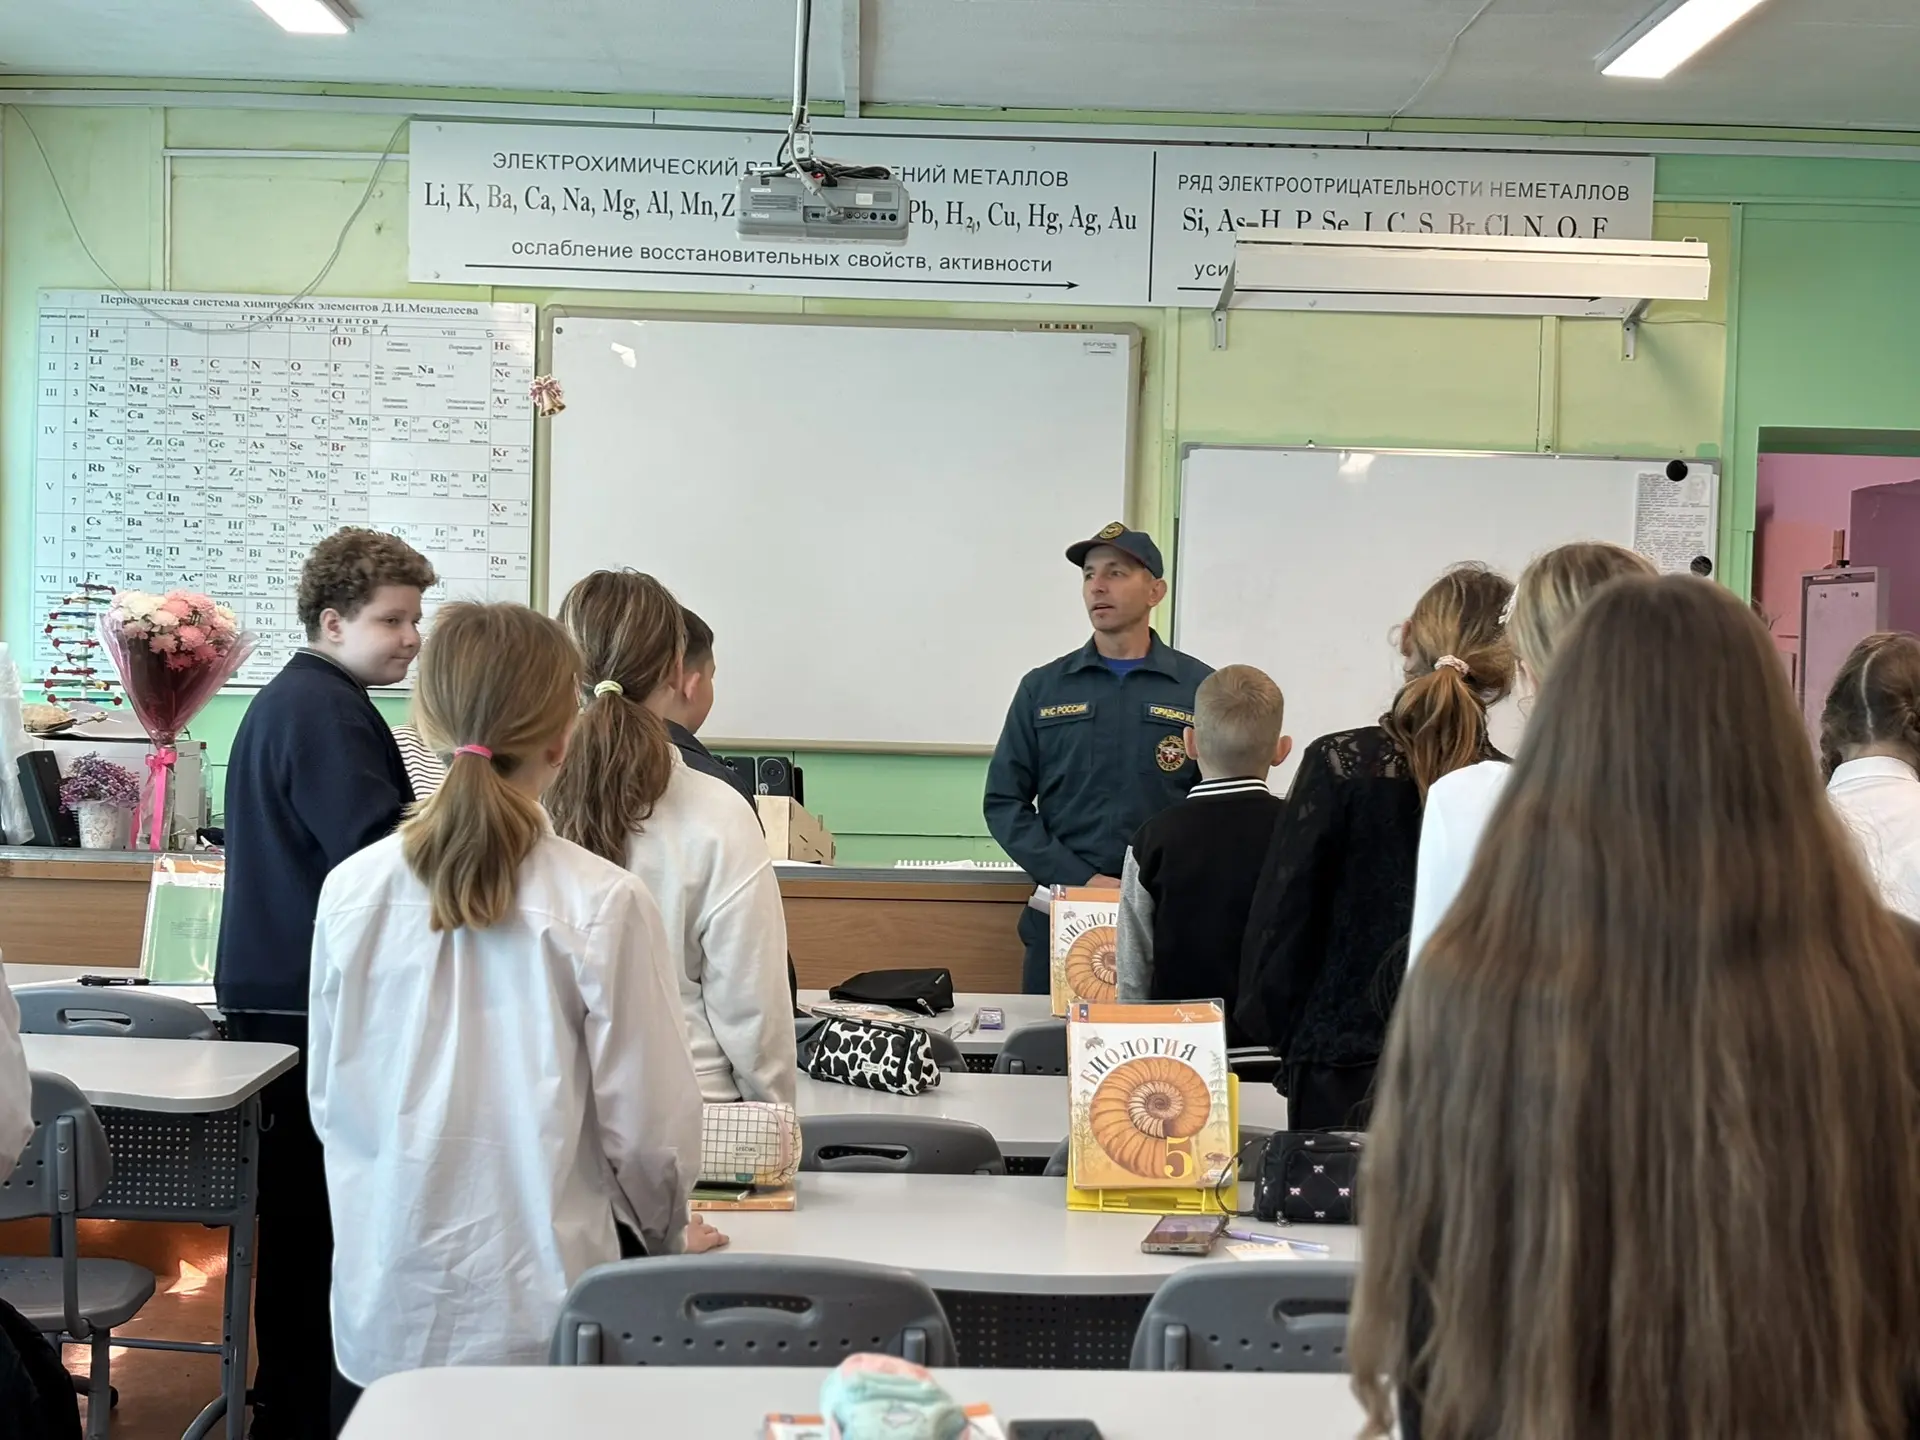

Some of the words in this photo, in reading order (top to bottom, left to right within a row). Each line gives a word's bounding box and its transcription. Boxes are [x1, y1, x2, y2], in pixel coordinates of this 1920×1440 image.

[493, 152, 738, 178] ЭЛЕКТРОХИМИЧЕСКИЙ
[953, 168, 1069, 187] МЕТАЛЛОВ
[1178, 174, 1213, 193] РЯД
[1218, 176, 1483, 198] ЭЛЕКТРООТРИЦАТЕЛЬНОСТИ
[1490, 182, 1630, 201] НЕМЕТАЛЛОВ
[425, 182, 451, 213] Li,
[457, 184, 480, 214] K,
[487, 184, 517, 215] Ba,
[525, 186, 556, 216] Ca,
[563, 187, 596, 217] Na,
[603, 189, 640, 220] Mg,
[647, 190, 673, 220] Al,
[909, 200, 938, 230] Pb,
[988, 202, 1020, 233] Cu,
[1028, 203, 1063, 235] Hg,
[1068, 205, 1101, 236] Ag,
[1108, 206, 1137, 230] Au
[1183, 207, 1209, 237] Si,
[1592, 217, 1608, 239] F
[511, 240, 634, 260] ослабление
[640, 246, 840, 267] восстановительных
[848, 251, 932, 271] свойств,
[940, 256, 1053, 273] активности
[100, 294, 189, 306] Периодическая
[194, 298, 240, 308] система
[318, 303, 378, 312] элементов
[381, 304, 478, 315] Д.И.Менделеева
[90, 329, 99, 338] H
[332, 336, 351, 347] (H)
[495, 342, 510, 351] He
[90, 357, 102, 365] Li
[210, 360, 219, 368] C
[252, 361, 260, 369] N
[48, 363, 56, 371] II
[291, 362, 301, 371] O
[334, 364, 341, 372] F
[417, 365, 434, 374] Na
[495, 369, 510, 378] Ne
[46, 388, 57, 396] III
[88, 383, 105, 392] Na
[129, 384, 148, 395] Mg
[169, 386, 182, 394] Al
[209, 387, 220, 396] Si
[252, 388, 259, 396] P
[291, 390, 299, 398] S
[332, 390, 345, 400] Cl
[494, 397, 508, 405] Ar
[89, 410, 99, 418] K
[128, 411, 143, 419] Ca
[191, 412, 205, 421] Sc
[234, 414, 245, 422] Ti
[276, 415, 285, 423] V
[311, 417, 326, 425] Cr
[349, 417, 368, 426] Mn
[394, 419, 408, 427] Fe
[433, 420, 449, 429] Co
[474, 421, 487, 430] Ni
[44, 426, 56, 435] IV
[106, 437, 123, 445] Cu
[147, 437, 162, 447] Zn
[168, 439, 184, 448] Ga
[250, 440, 264, 449] As
[290, 442, 303, 450] Se
[331, 443, 346, 452] Br
[492, 448, 508, 457] Kr
[88, 463, 105, 472] Rb
[127, 465, 141, 474] Sr
[194, 466, 202, 474] Y
[230, 468, 244, 476] Zr
[72, 472, 77, 480] 6
[269, 469, 285, 477] Nb
[307, 470, 326, 479] Mo
[391, 473, 407, 482] Ru
[431, 473, 447, 482] Rh
[472, 474, 487, 482] Pd
[106, 492, 121, 501] Ag
[146, 492, 163, 500] Cd
[168, 494, 179, 502] In
[208, 494, 222, 503] Sn
[249, 496, 263, 505] Sb
[290, 497, 303, 505] Te
[331, 498, 335, 506] I
[492, 503, 507, 512] Xe
[87, 517, 101, 526] Cs
[127, 518, 142, 526] Ba
[228, 520, 243, 529] Hf
[273, 523, 284, 531] Ta
[313, 524, 325, 532] W
[435, 528, 446, 536] Ir
[473, 529, 484, 537] Pt
[105, 546, 121, 554] Au
[146, 546, 162, 556] Hg
[208, 548, 223, 557] Pb
[249, 549, 261, 558] Bi
[491, 557, 507, 565] Rn
[41, 575, 56, 583] VII
[126, 573, 142, 581] Ra
[228, 574, 243, 583] Rf
[267, 576, 284, 585] Db
[1060, 911, 1117, 945] БИОЛОГ
[1080, 1036, 1198, 1085] БИОЛОГИЯ
[1164, 1136, 1193, 1179] 5
